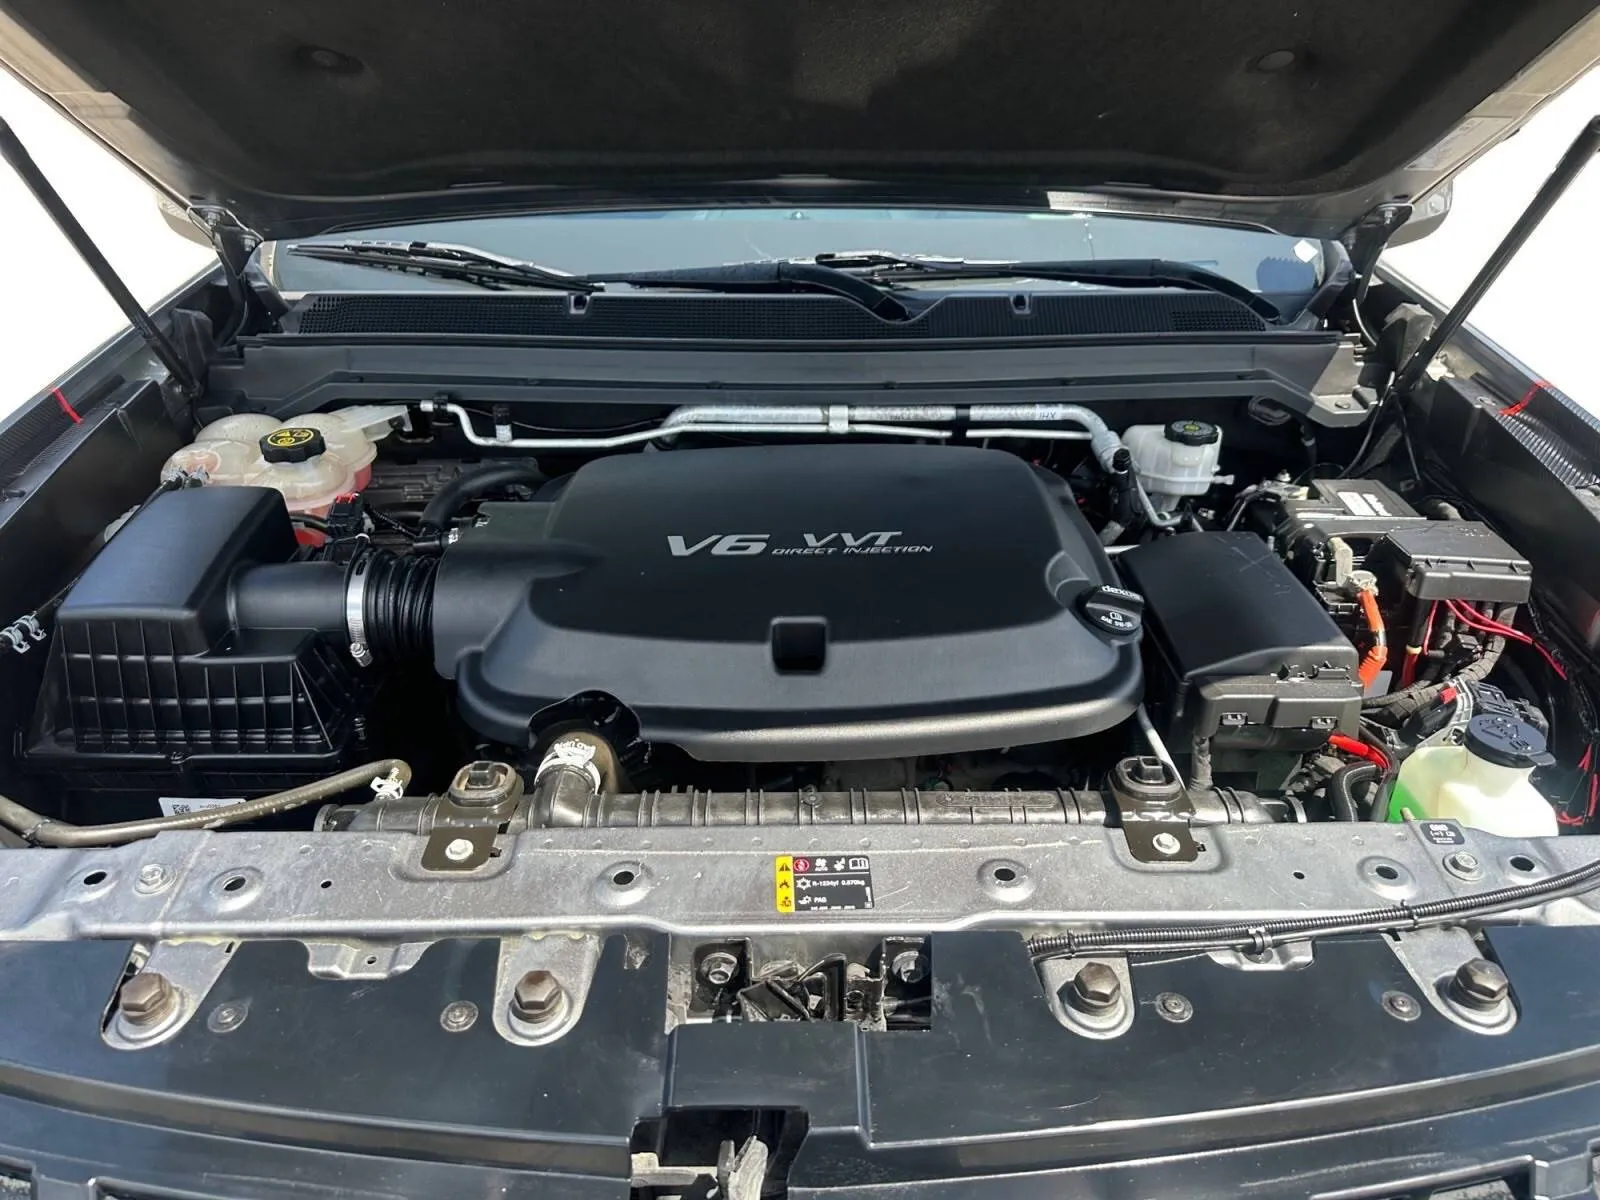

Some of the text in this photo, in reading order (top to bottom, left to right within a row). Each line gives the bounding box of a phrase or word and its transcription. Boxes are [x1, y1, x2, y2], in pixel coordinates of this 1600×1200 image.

[667, 530, 903, 557] V6 VVT
[771, 544, 934, 556] DIRECT INJECTION
[1100, 615, 1113, 625] SAE
